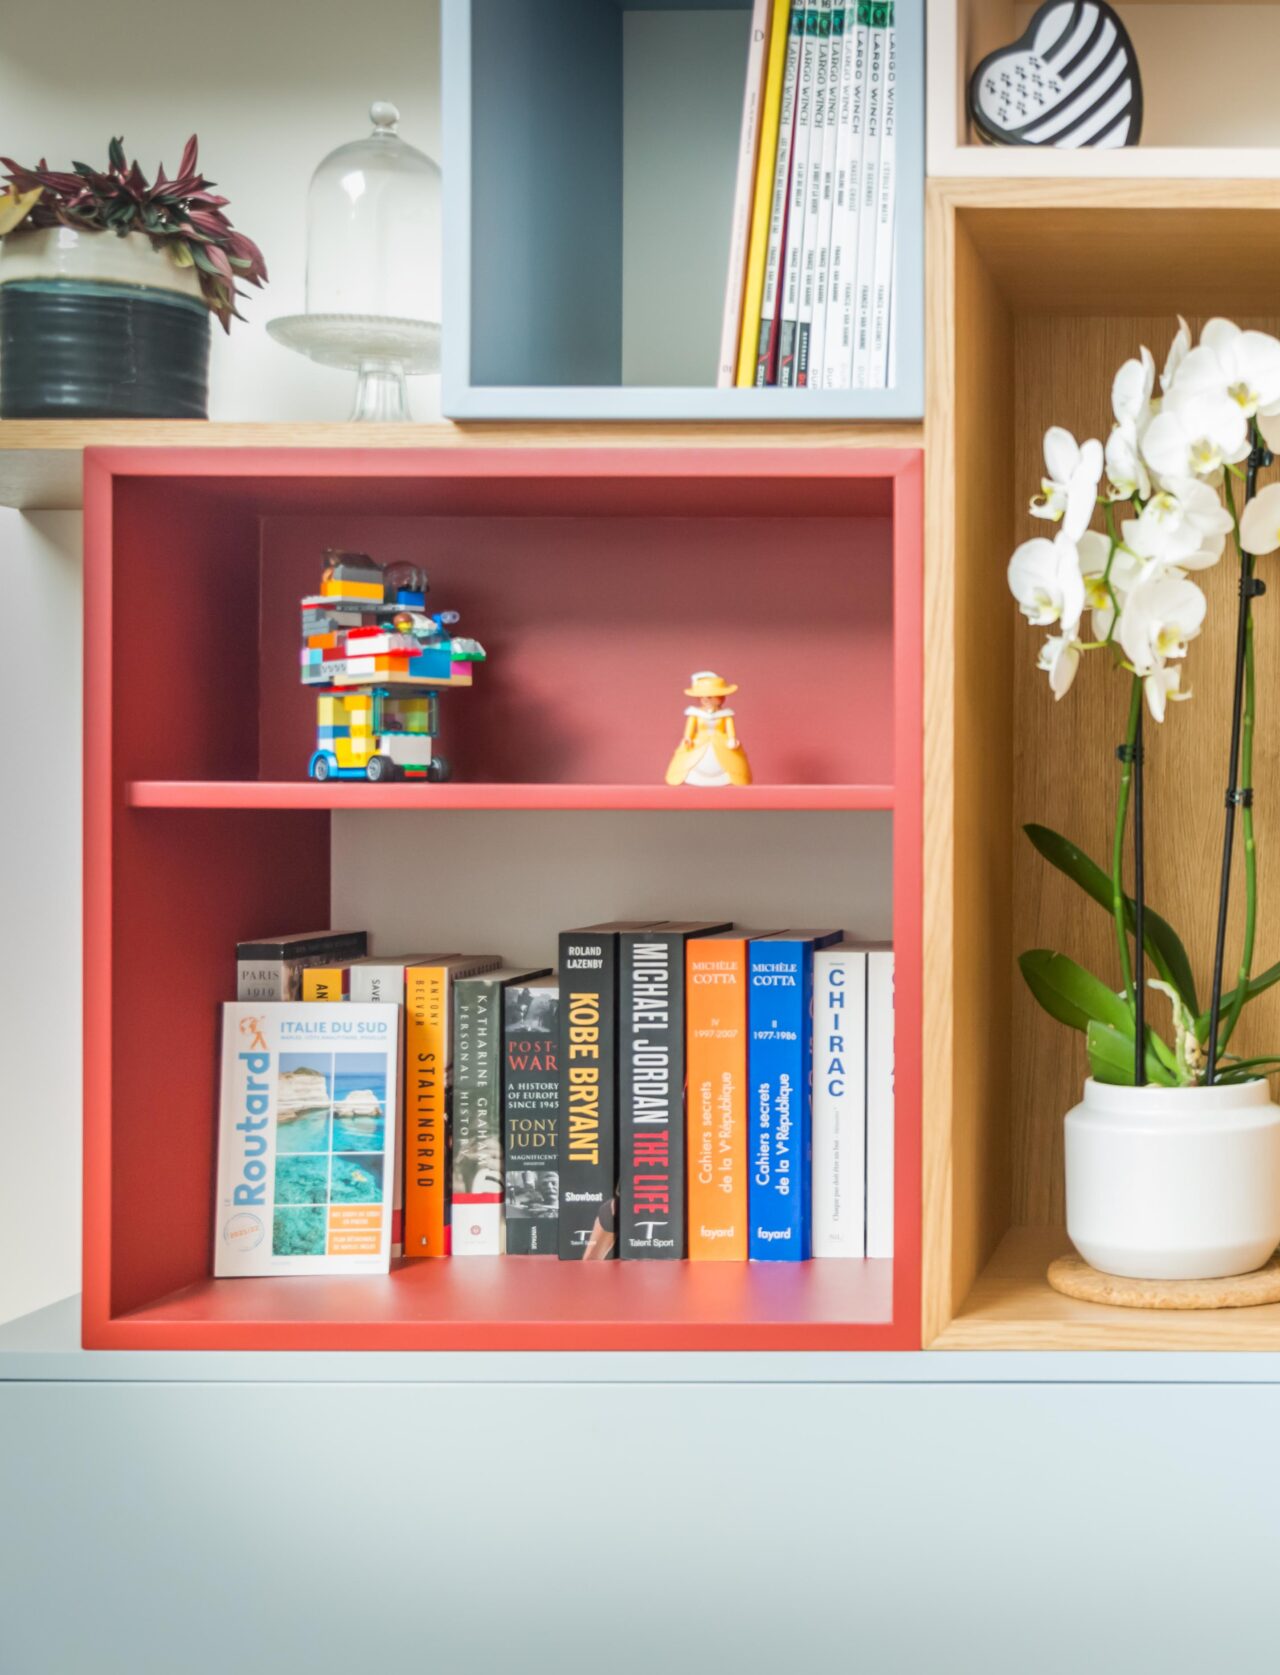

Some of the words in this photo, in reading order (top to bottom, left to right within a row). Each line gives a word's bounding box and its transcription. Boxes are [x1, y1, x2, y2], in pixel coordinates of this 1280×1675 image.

[803, 42, 813, 82] LARGO
[818, 44, 828, 85] LARGO
[830, 42, 840, 82] LARGO
[844, 41, 853, 81] LARGO
[855, 31, 864, 79] LARGO
[872, 33, 881, 82] LARGO
[888, 33, 896, 82] LARGO
[800, 87, 810, 126] WINCH
[815, 89, 824, 128] WINCH
[827, 86, 837, 126] WINCH
[841, 85, 850, 124] WINCH
[852, 85, 861, 134] WINCH
[869, 88, 879, 136] WINCH
[886, 88, 894, 136] WINCH
[567, 959, 603, 970] LAZENBY
[568, 946, 602, 957] ROLAND
[692, 960, 738, 972] MICHÈLE
[752, 961, 798, 973] MICHÈLE
[242, 970, 280, 981] PARIS
[315, 983, 329, 1002] AN
[632, 943, 669, 1034] MICHAEL
[693, 973, 737, 986] COTTA
[753, 975, 797, 987] COTTA
[415, 980, 424, 1027] BEEVOR
[430, 979, 439, 1027] ANTONY
[280, 1021, 327, 1033] ITALIE
[331, 1021, 352, 1033] DU
[357, 1021, 388, 1033] SUD
[460, 1005, 469, 1081] PERSONAL
[477, 994, 488, 1088] KATHARINE
[569, 992, 599, 1060] KOBE
[693, 1029, 738, 1039] 1997-2007
[753, 1031, 797, 1041] 1977-1986
[827, 969, 846, 1098] CHIRAC
[508, 1041, 558, 1053] POST-
[508, 1056, 559, 1071] WAR
[508, 1092, 520, 1100] OF
[523, 1092, 559, 1100] EUROPE
[518, 1082, 559, 1090] HISTORY
[632, 1038, 669, 1124] JORDAN
[417, 1053, 435, 1188] STALINGRAD
[460, 1091, 469, 1155] HISTORY
[539, 1101, 560, 1109] 1945
[568, 1067, 599, 1165] BRYANT
[700, 1081, 712, 1127] secrets
[718, 1071, 736, 1139] République
[758, 1082, 770, 1128] secrets
[774, 1073, 794, 1141] République
[233, 1053, 270, 1206] Routard
[477, 1097, 488, 1166] GRAHAM
[509, 1118, 558, 1131] TONY
[509, 1134, 559, 1150] JUDT
[632, 1130, 669, 1168] THE
[698, 1131, 713, 1185] Cahiers
[718, 1158, 733, 1171] la
[755, 1132, 770, 1186] Cahiers
[774, 1160, 790, 1173] la
[565, 1191, 603, 1202] Showboat
[632, 1173, 669, 1215] LIFE
[718, 1175, 733, 1193] de
[774, 1177, 790, 1195] de
[629, 1239, 652, 1247] Talent
[653, 1239, 674, 1248] Sport
[700, 1225, 735, 1239] fayard
[757, 1227, 792, 1241] fayard
